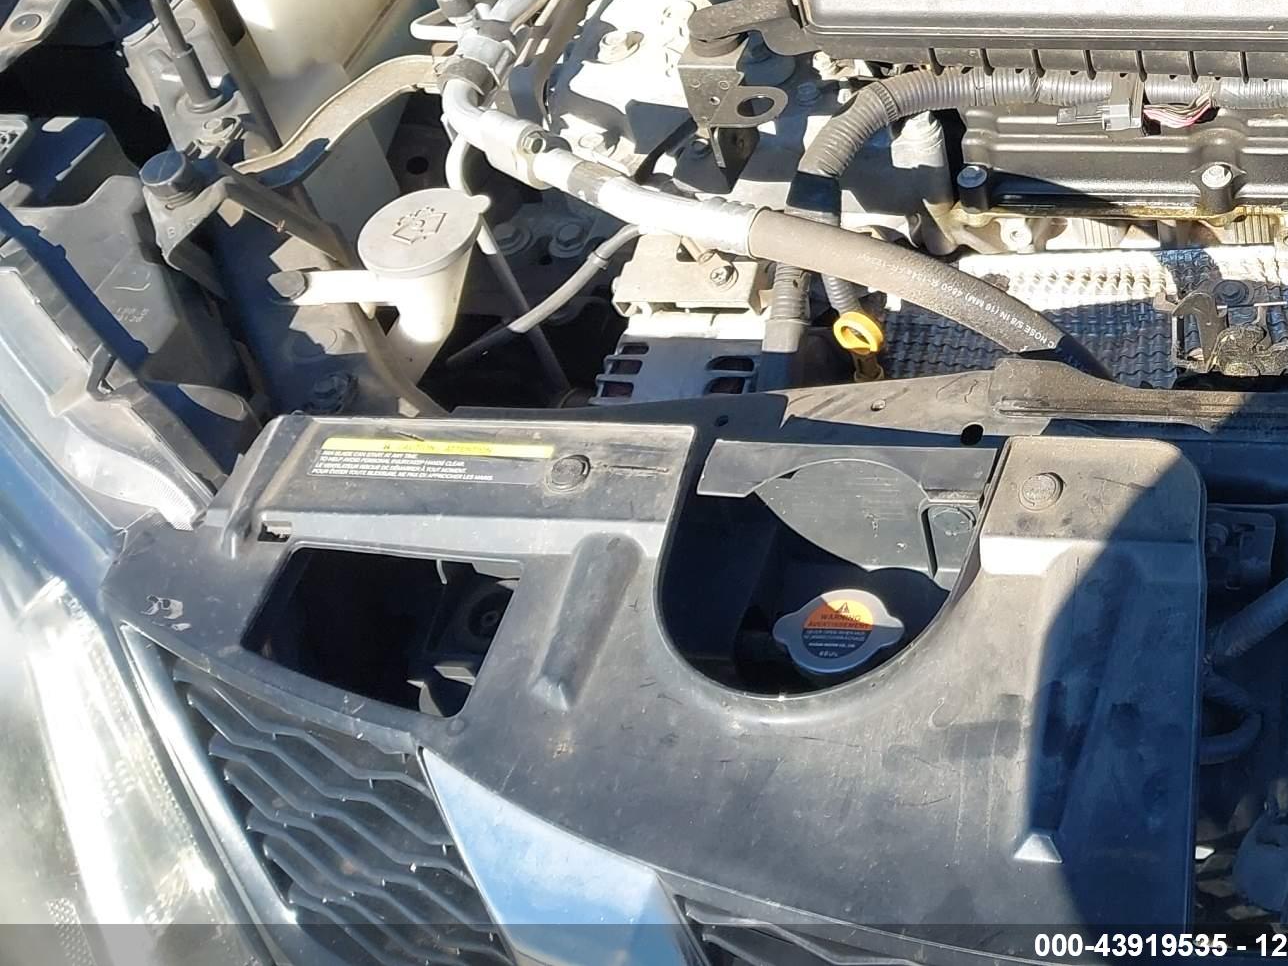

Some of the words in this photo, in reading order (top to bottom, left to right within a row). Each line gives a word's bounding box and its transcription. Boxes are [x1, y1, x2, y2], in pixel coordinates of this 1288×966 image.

[965, 292, 985, 308] MM)
[999, 311, 1010, 322] IN
[1010, 318, 1025, 330] 5/8
[1024, 324, 1048, 344] HOSE
